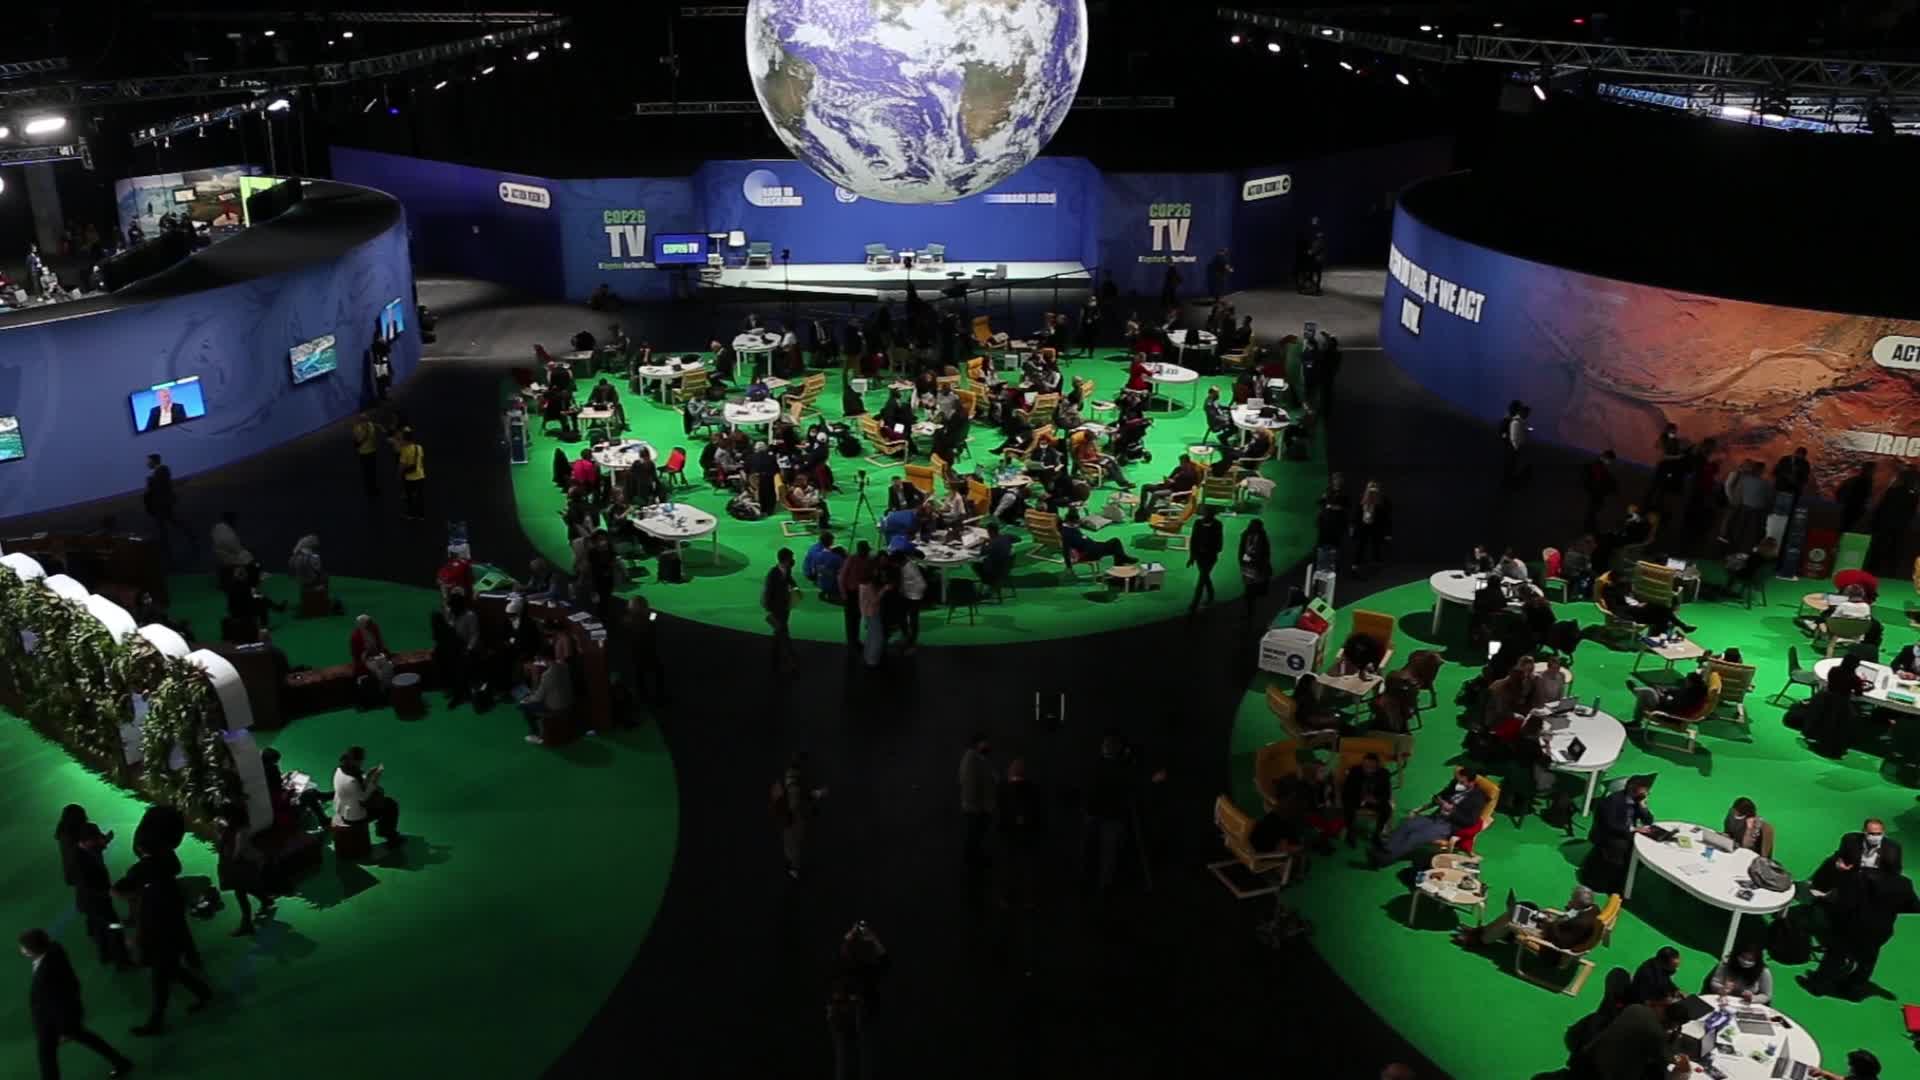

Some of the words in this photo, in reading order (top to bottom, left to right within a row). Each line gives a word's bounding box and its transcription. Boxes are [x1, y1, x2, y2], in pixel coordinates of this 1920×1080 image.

[604, 209, 646, 224] COP26
[1150, 203, 1192, 217] COP26
[605, 224, 646, 258] TV
[1150, 218, 1191, 251] TV
[1438, 279, 1459, 313] WE
[1455, 287, 1486, 323] ACT
